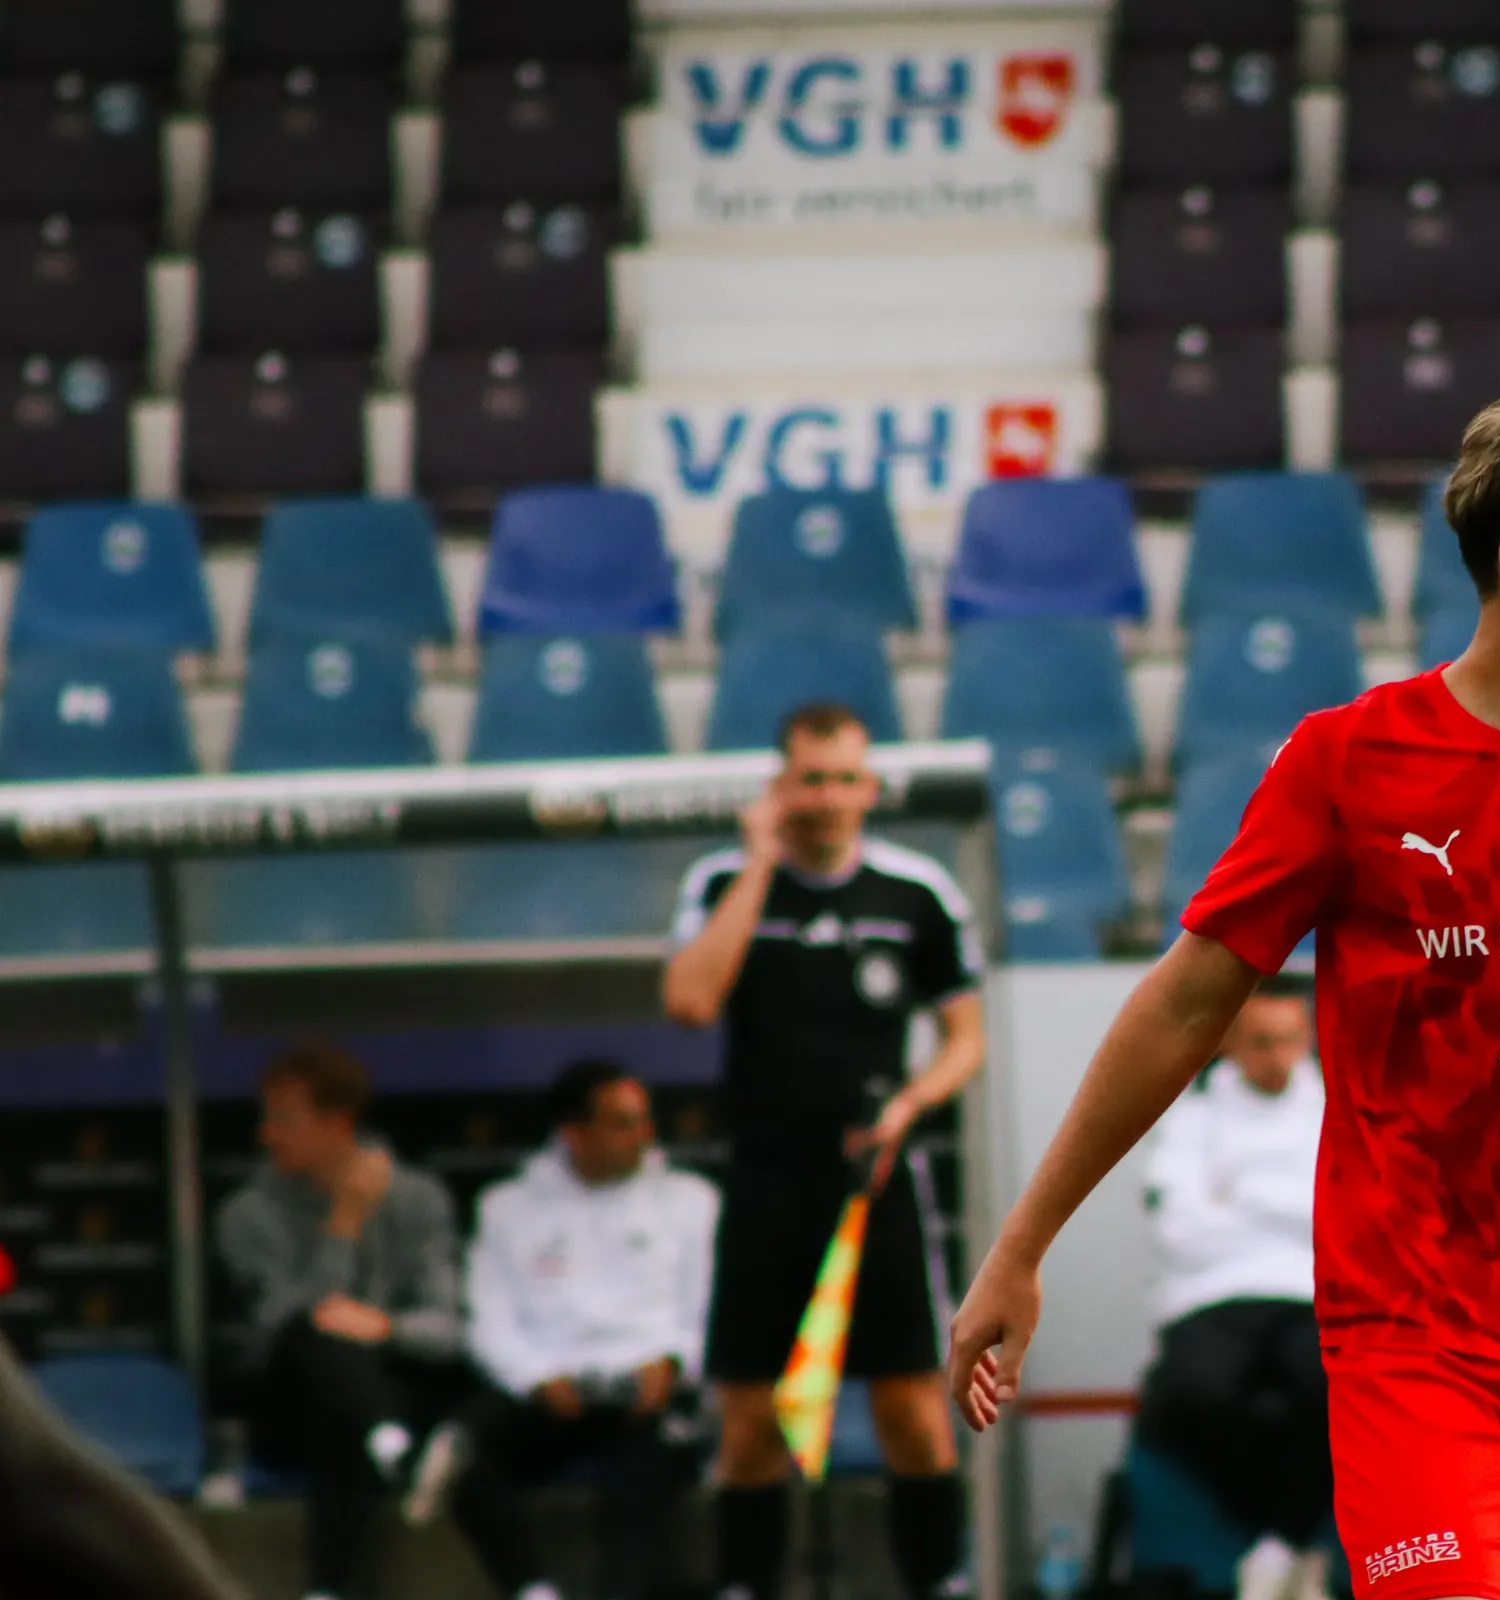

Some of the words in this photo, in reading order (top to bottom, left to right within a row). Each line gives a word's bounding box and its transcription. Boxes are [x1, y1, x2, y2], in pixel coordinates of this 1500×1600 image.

[683, 56, 970, 158] VGH
[664, 405, 951, 496] VGH
[1416, 925, 1489, 959] WIR
[1366, 1531, 1456, 1564] ELEKTRO
[1367, 1541, 1460, 1584] PRINZ
